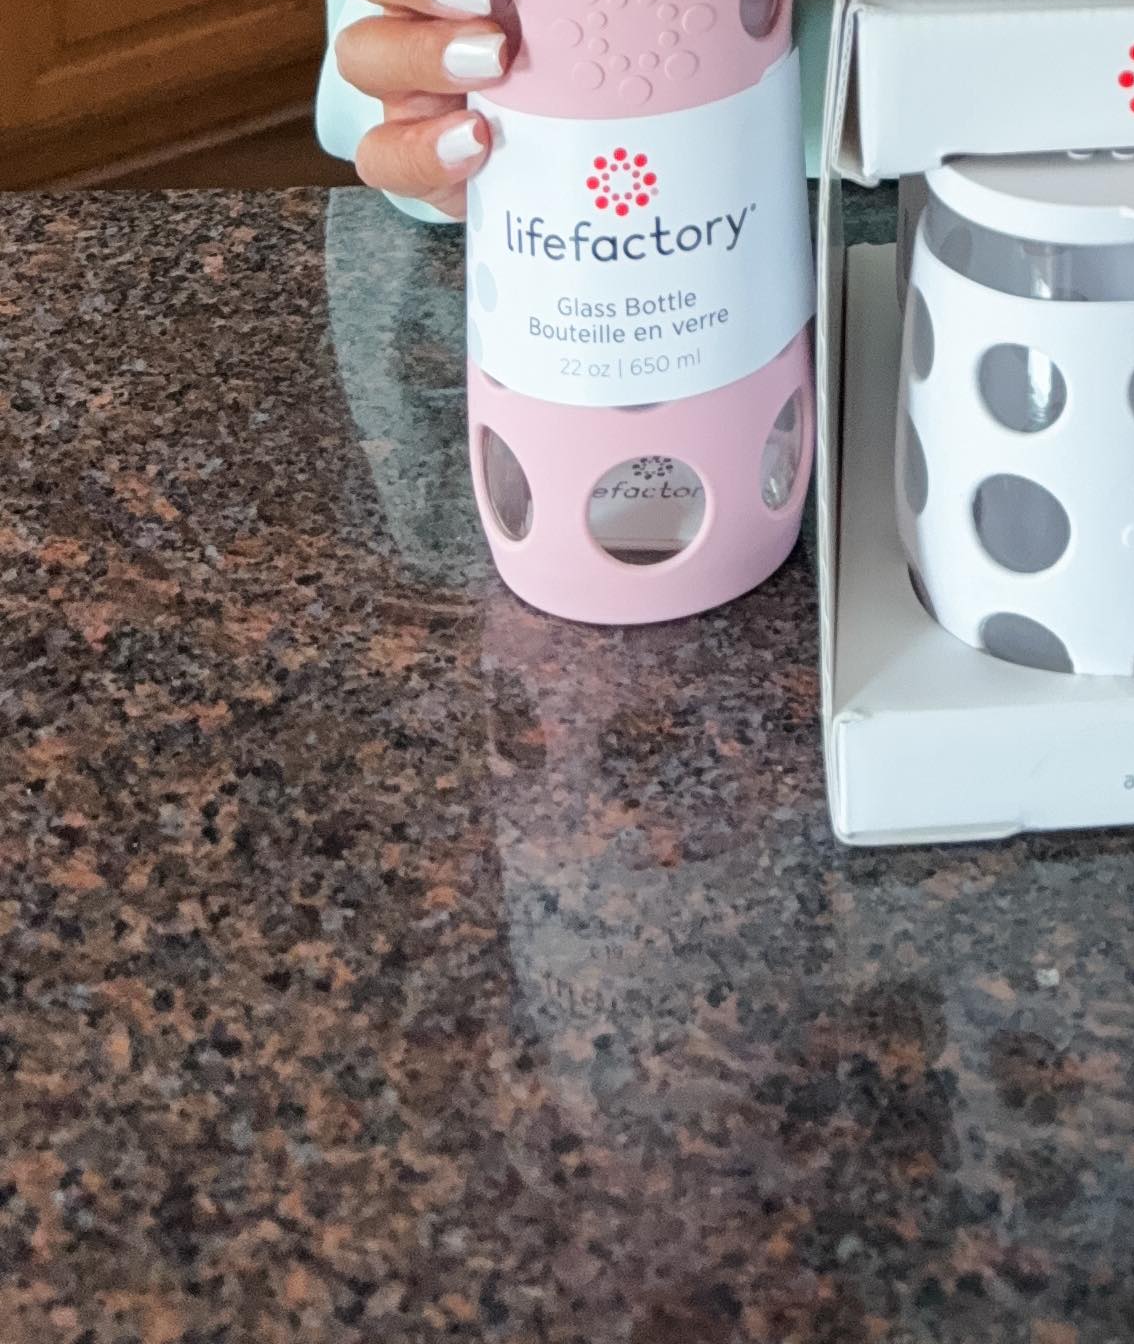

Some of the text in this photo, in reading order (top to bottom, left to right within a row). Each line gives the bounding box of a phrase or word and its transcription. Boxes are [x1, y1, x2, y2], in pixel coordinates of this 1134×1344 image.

[505, 205, 749, 263] lifefactory
[557, 289, 697, 318] Glass Bottle
[529, 307, 729, 344] Bouteille en verre
[560, 357, 582, 376] 22
[588, 362, 611, 378] oz
[630, 354, 670, 376] 650
[677, 348, 702, 369] ml
[592, 480, 705, 499] efactor
